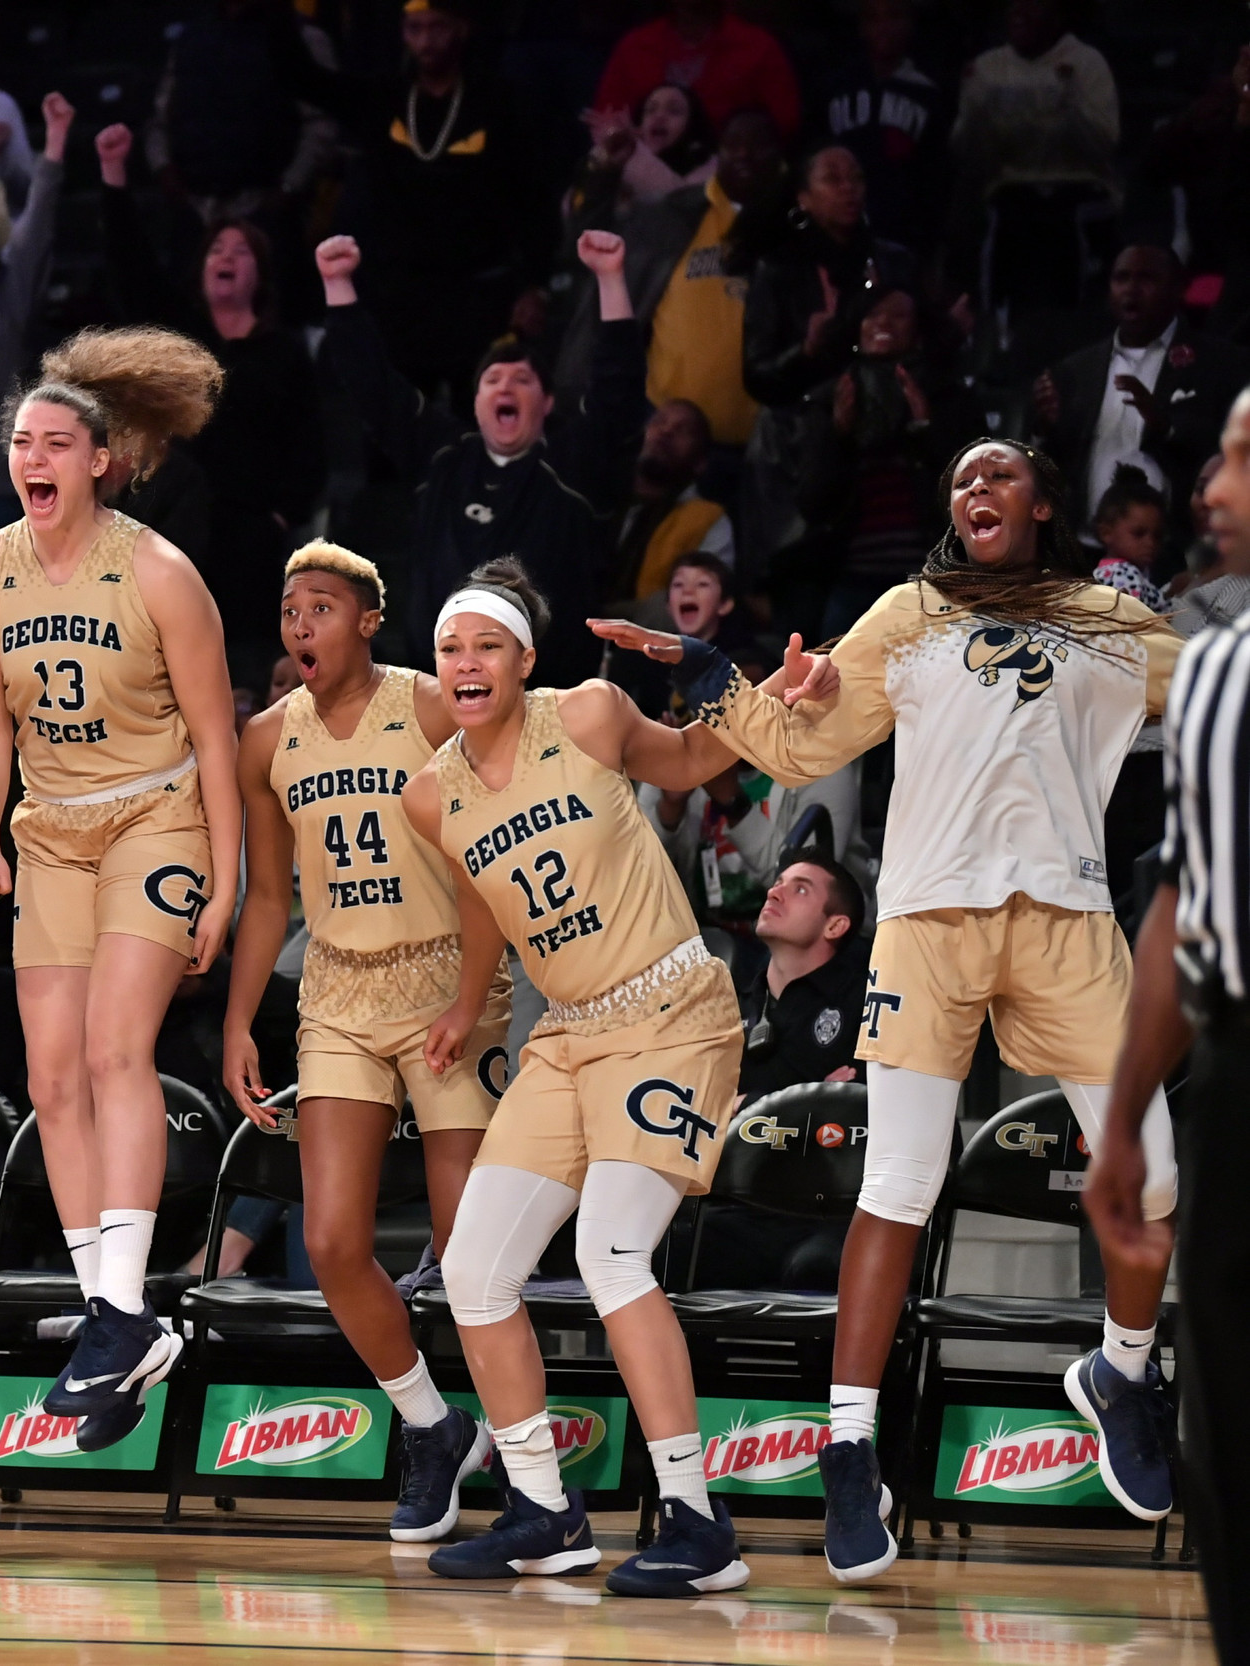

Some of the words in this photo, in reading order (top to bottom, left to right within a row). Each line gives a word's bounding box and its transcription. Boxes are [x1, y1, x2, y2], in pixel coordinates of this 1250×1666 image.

[2, 614, 123, 654] GEORGIA
[33, 659, 86, 713] 13
[28, 715, 109, 745] TECH
[287, 767, 410, 813] GEORGIA
[324, 810, 389, 869] 44
[463, 793, 594, 879] GEORGIA
[328, 875, 404, 909] TECH
[509, 849, 576, 920] 12
[527, 903, 604, 959] TECH
[166, 1112, 202, 1132] NC
[625, 1077, 717, 1165] GT
[739, 1115, 799, 1150] GT
[995, 1121, 1058, 1157] GT
[214, 1406, 363, 1470] LIBMAN
[703, 1425, 833, 1482] LIBMAN
[954, 1434, 1100, 1495] LIBMAN
